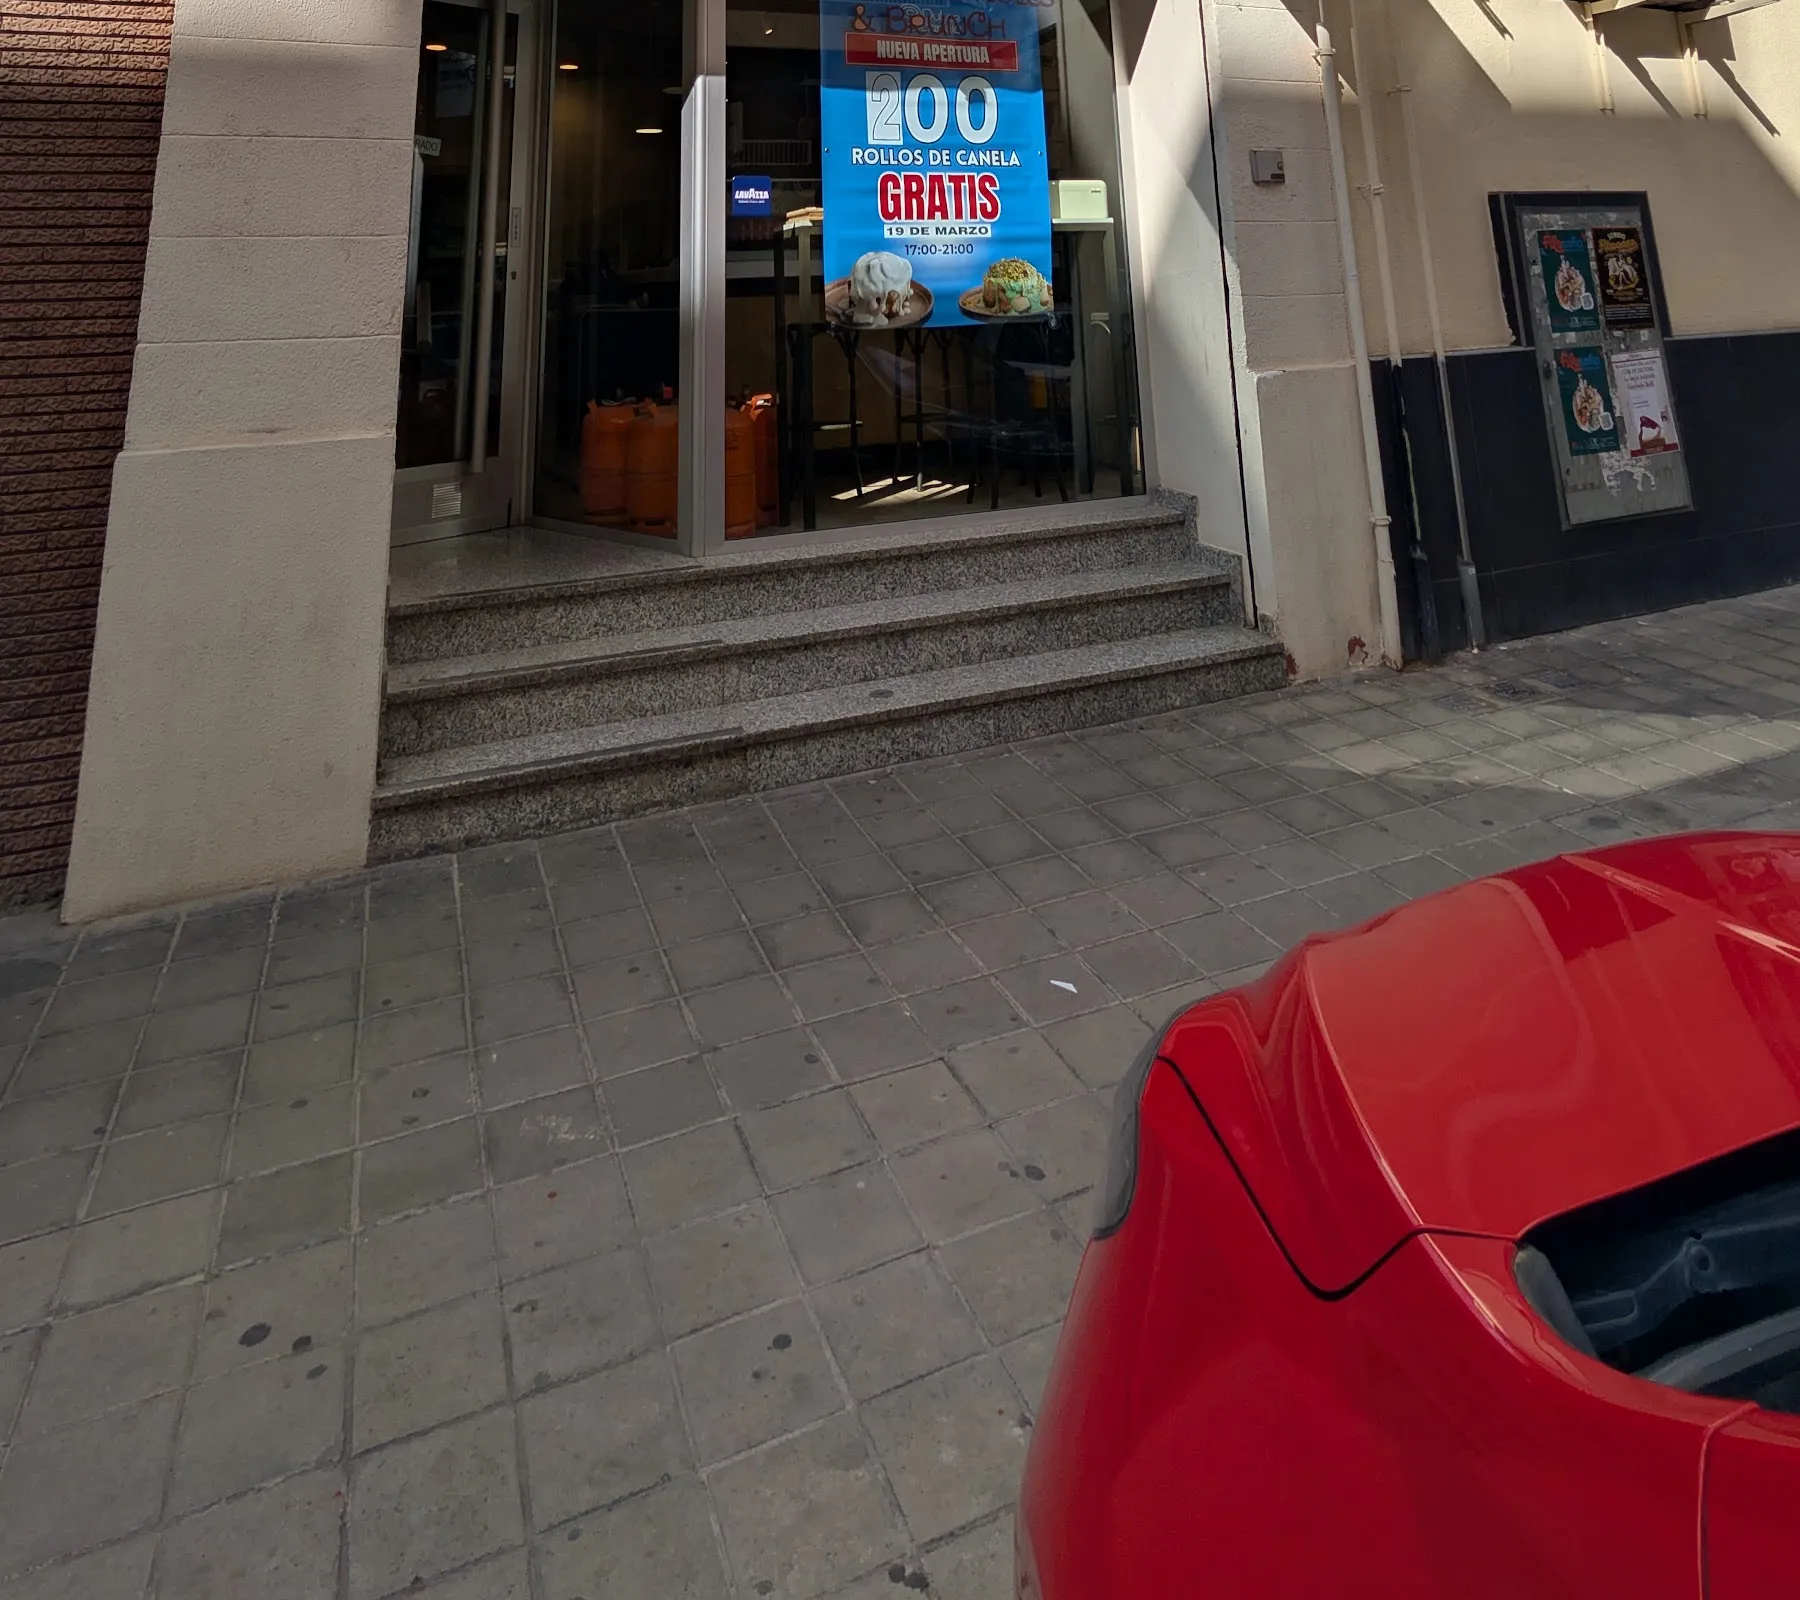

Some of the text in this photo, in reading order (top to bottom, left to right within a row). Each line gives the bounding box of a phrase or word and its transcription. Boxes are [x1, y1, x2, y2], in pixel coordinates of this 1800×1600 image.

[876, 40, 990, 64] NUEVA APERTURA
[871, 72, 999, 145] 200
[851, 147, 1022, 167] ROLLOS DE CANELA
[734, 187, 770, 199] LAVAZZA
[877, 170, 1001, 223] GRATIS
[886, 226, 989, 236] 19 DE MARZO
[904, 243, 974, 256] 17:00-21:00
